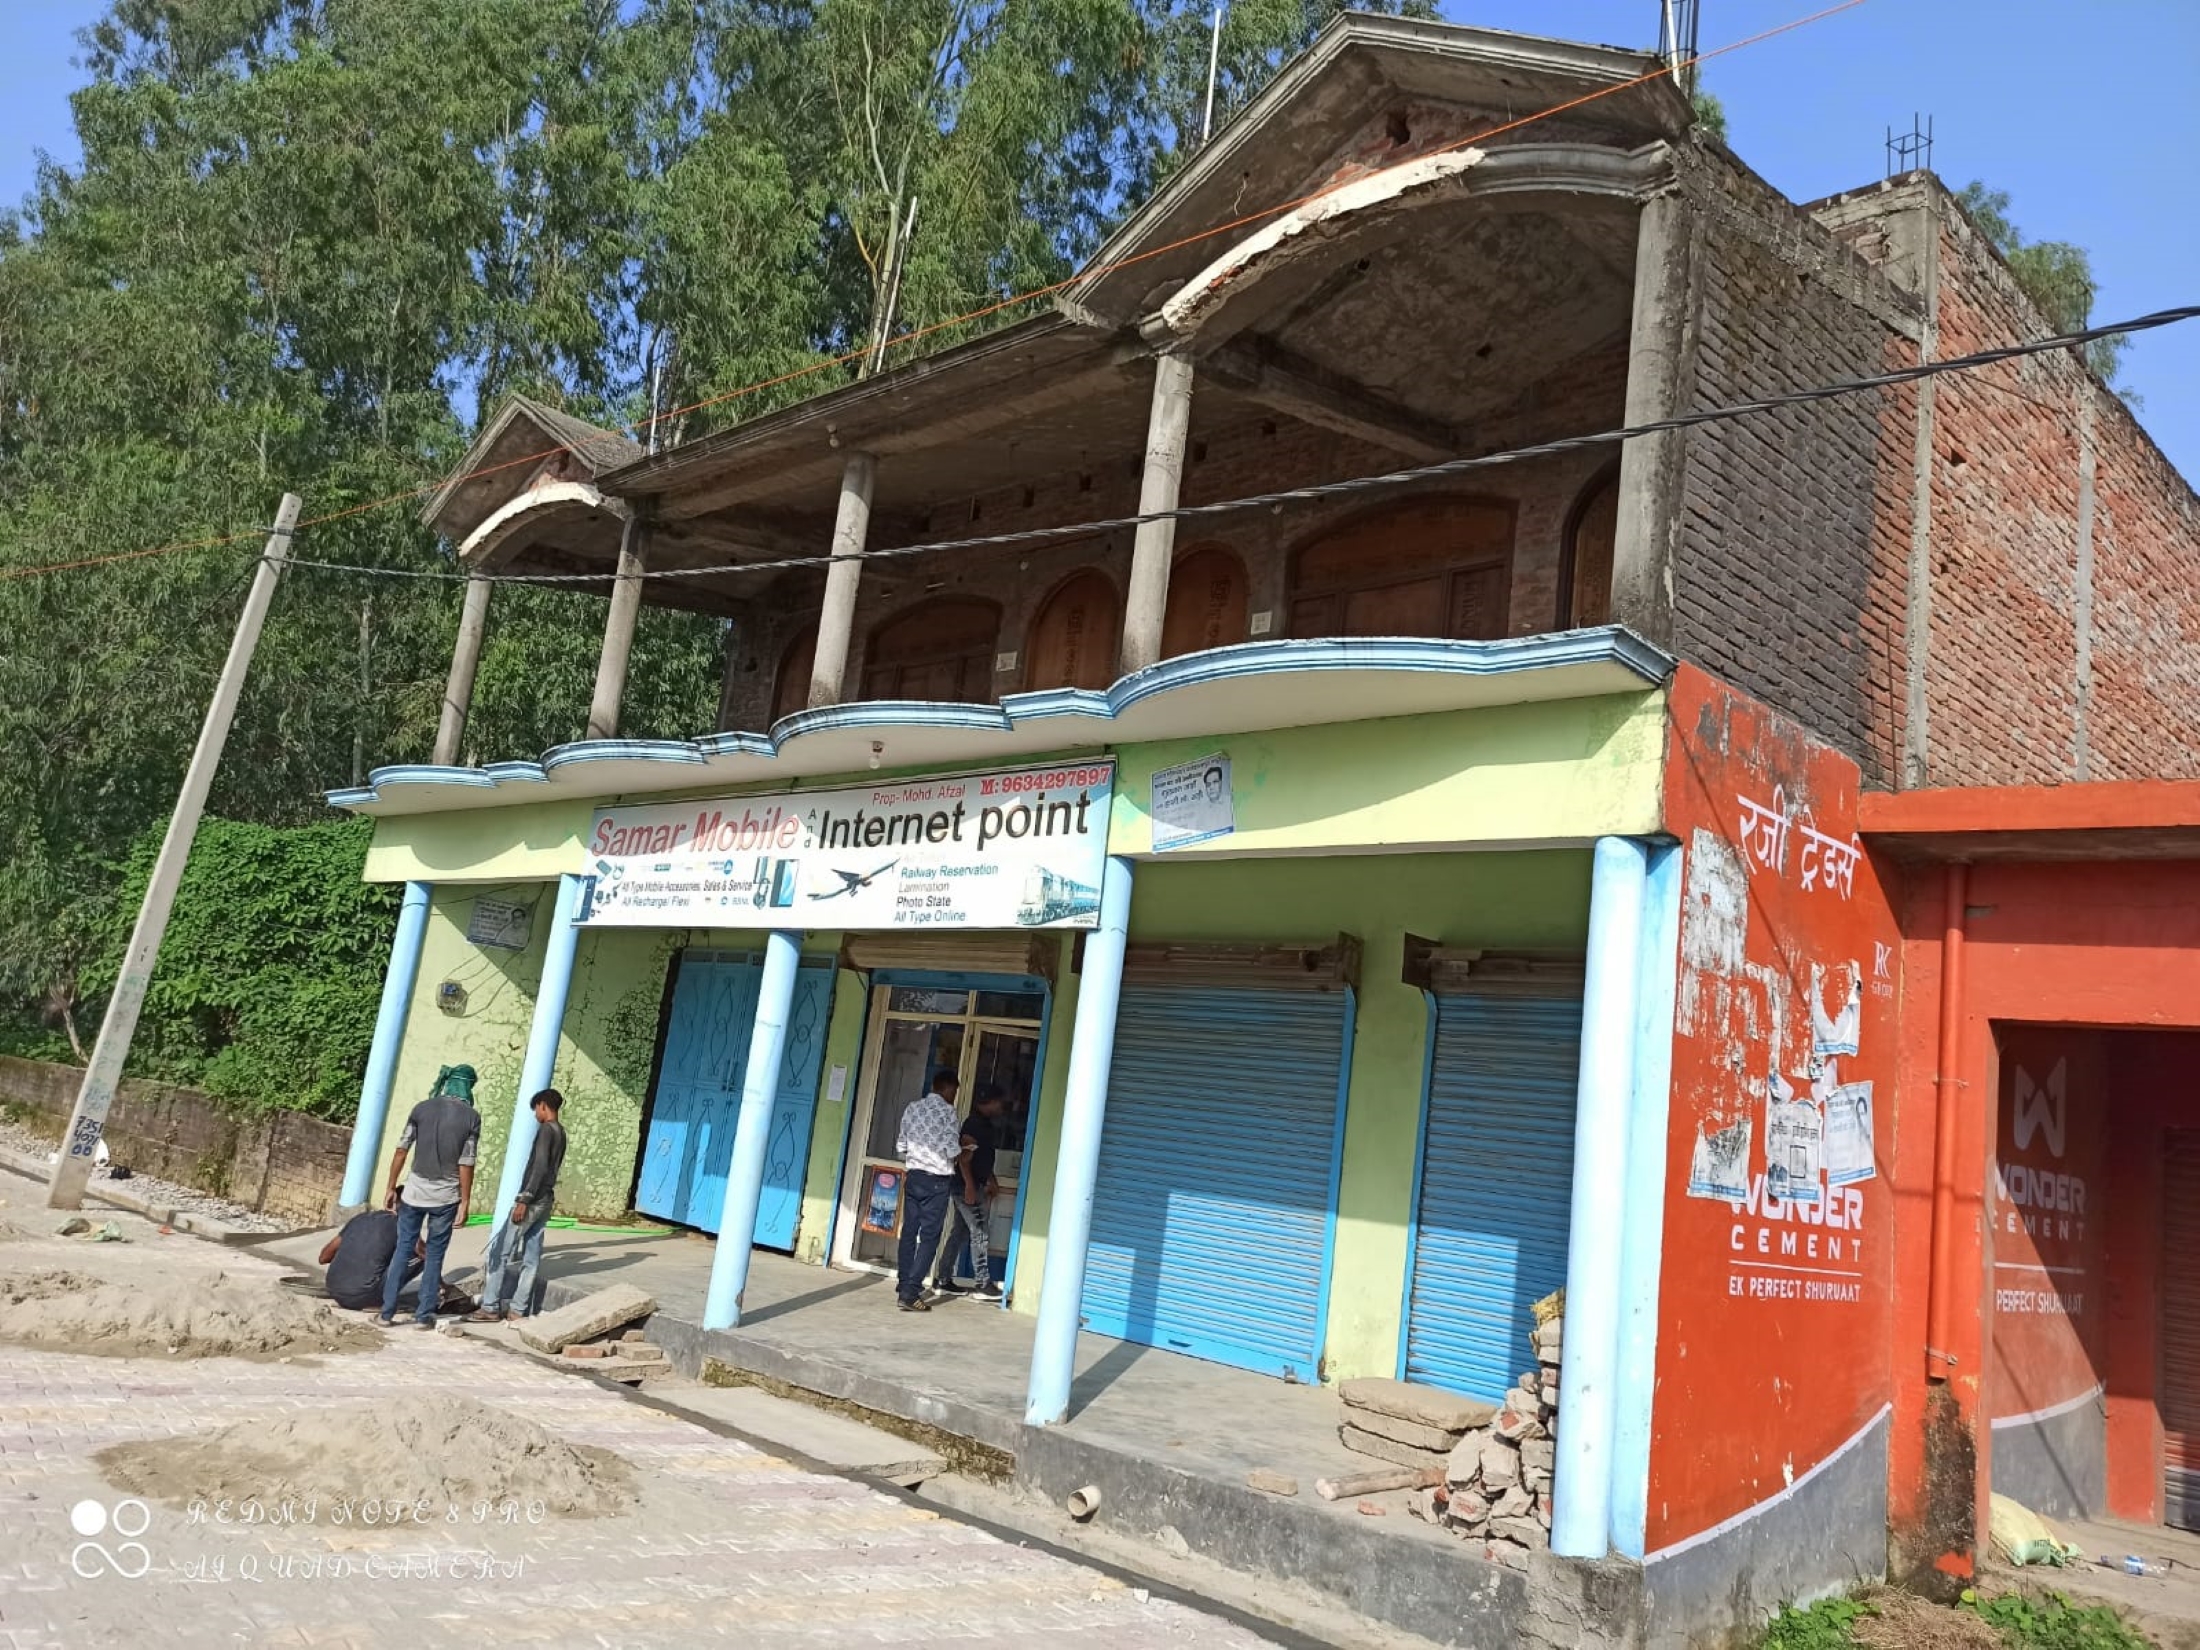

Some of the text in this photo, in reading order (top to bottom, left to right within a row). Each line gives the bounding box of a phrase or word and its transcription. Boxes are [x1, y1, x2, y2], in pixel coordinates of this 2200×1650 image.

[938, 784, 966, 799] Afzal
[819, 800, 966, 849] Internet
[977, 789, 1091, 851] point
[592, 806, 800, 857] Samar Mobile
[901, 864, 999, 880] Railway Reservation
[728, 879, 752, 891] Service
[898, 882, 950, 893] Lamination
[896, 895, 951, 907] Photo State
[894, 910, 966, 924] All Type Online
[1993, 1210, 2084, 1240] EMENT
[1731, 1224, 1861, 1263] CEMENT
[1729, 1275, 1861, 1302] EK PERFECT SHURUAAT
[1996, 1289, 2035, 1312] PERFECT
